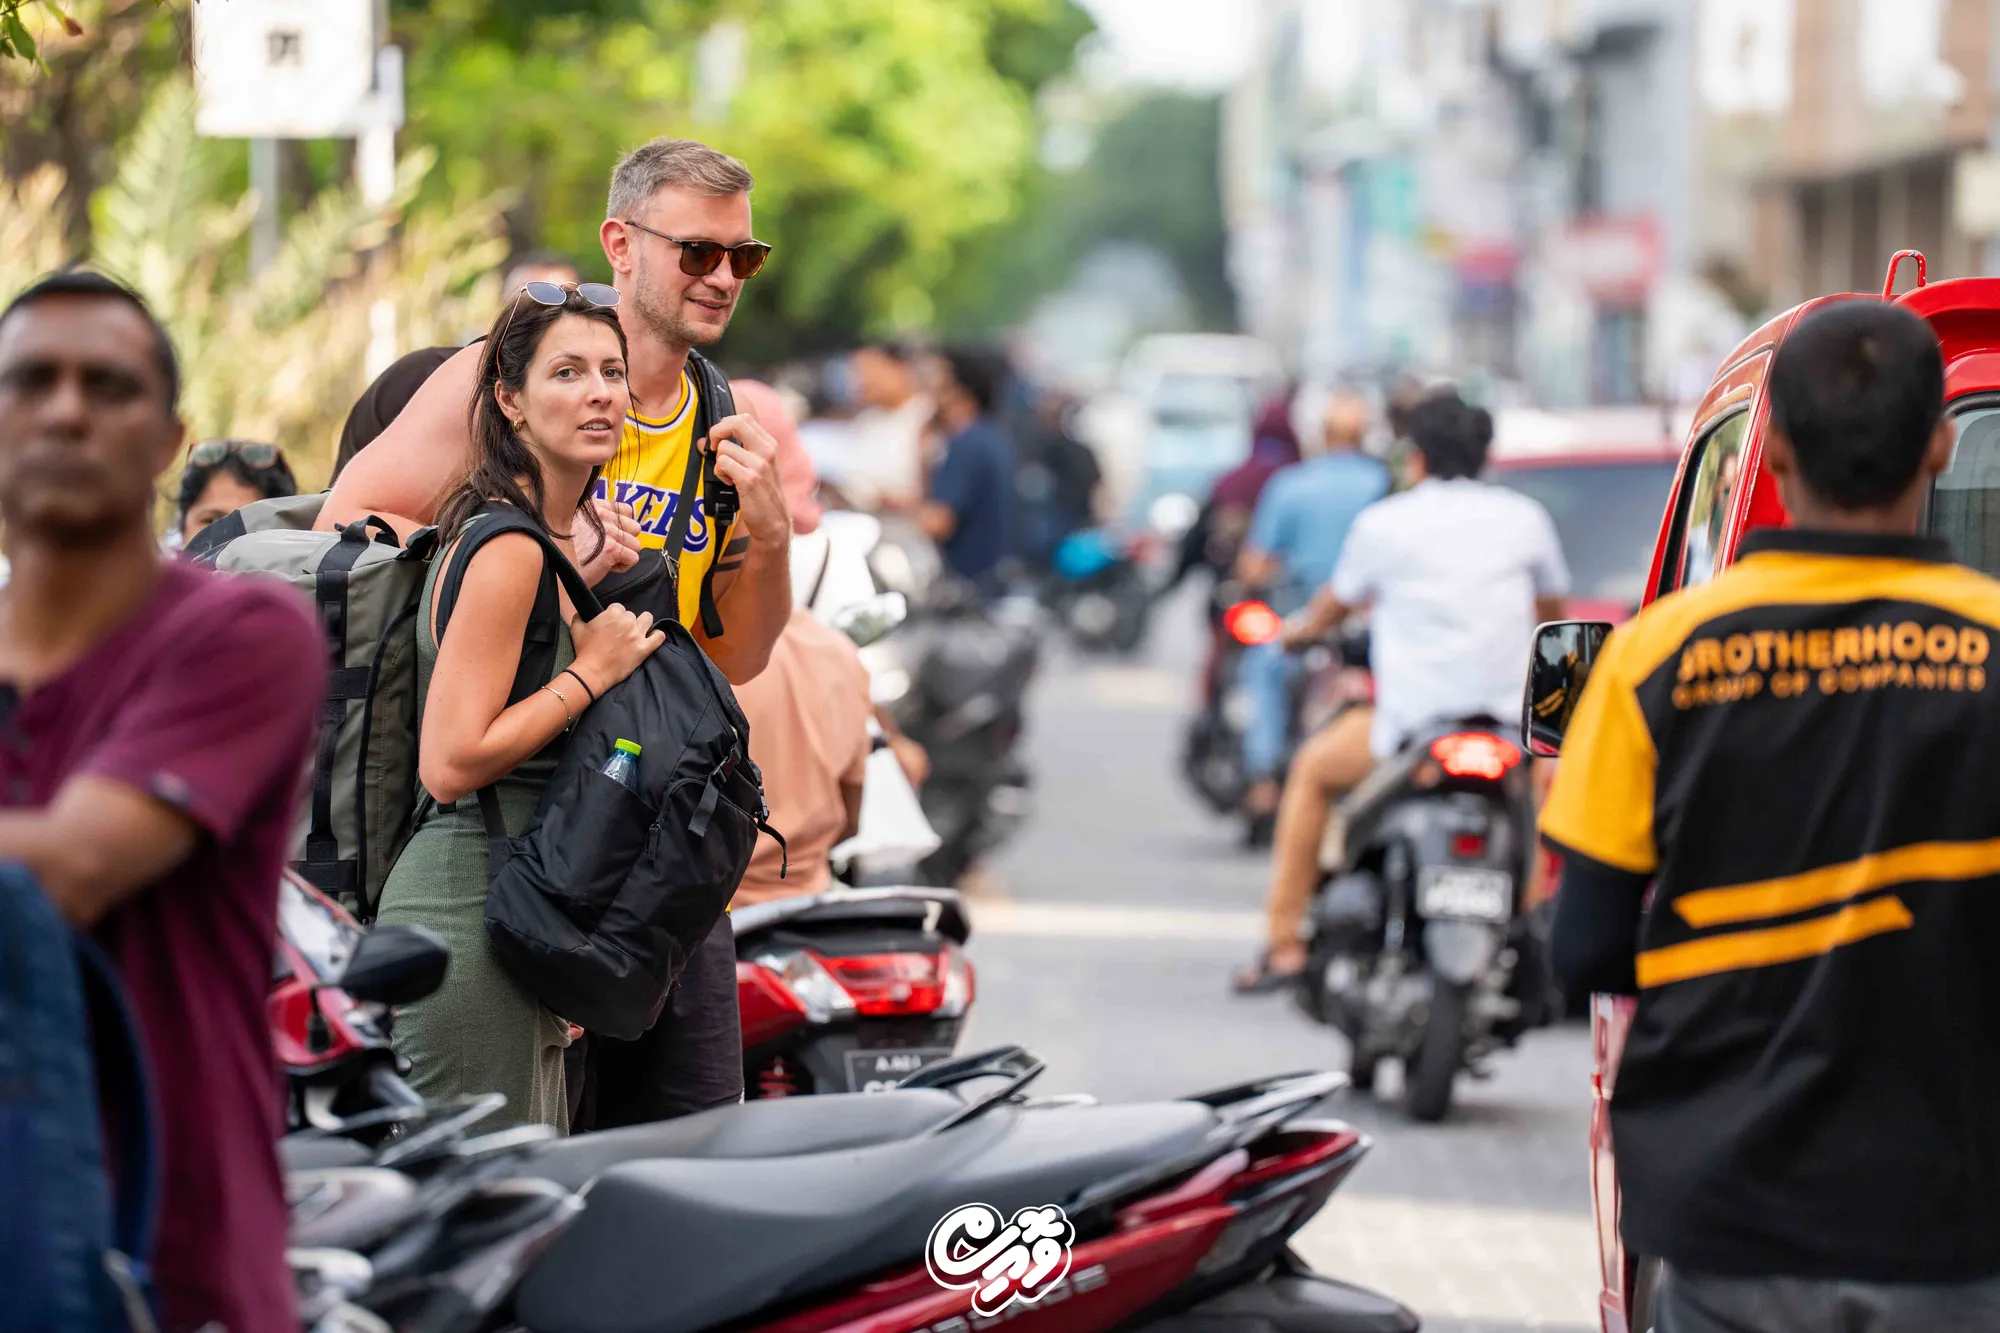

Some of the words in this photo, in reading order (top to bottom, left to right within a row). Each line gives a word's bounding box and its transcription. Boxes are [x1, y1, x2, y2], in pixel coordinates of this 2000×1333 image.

[590, 476, 709, 553] AKERS
[1770, 667, 1810, 699] OF
[1818, 659, 1986, 695] COMPANIES
